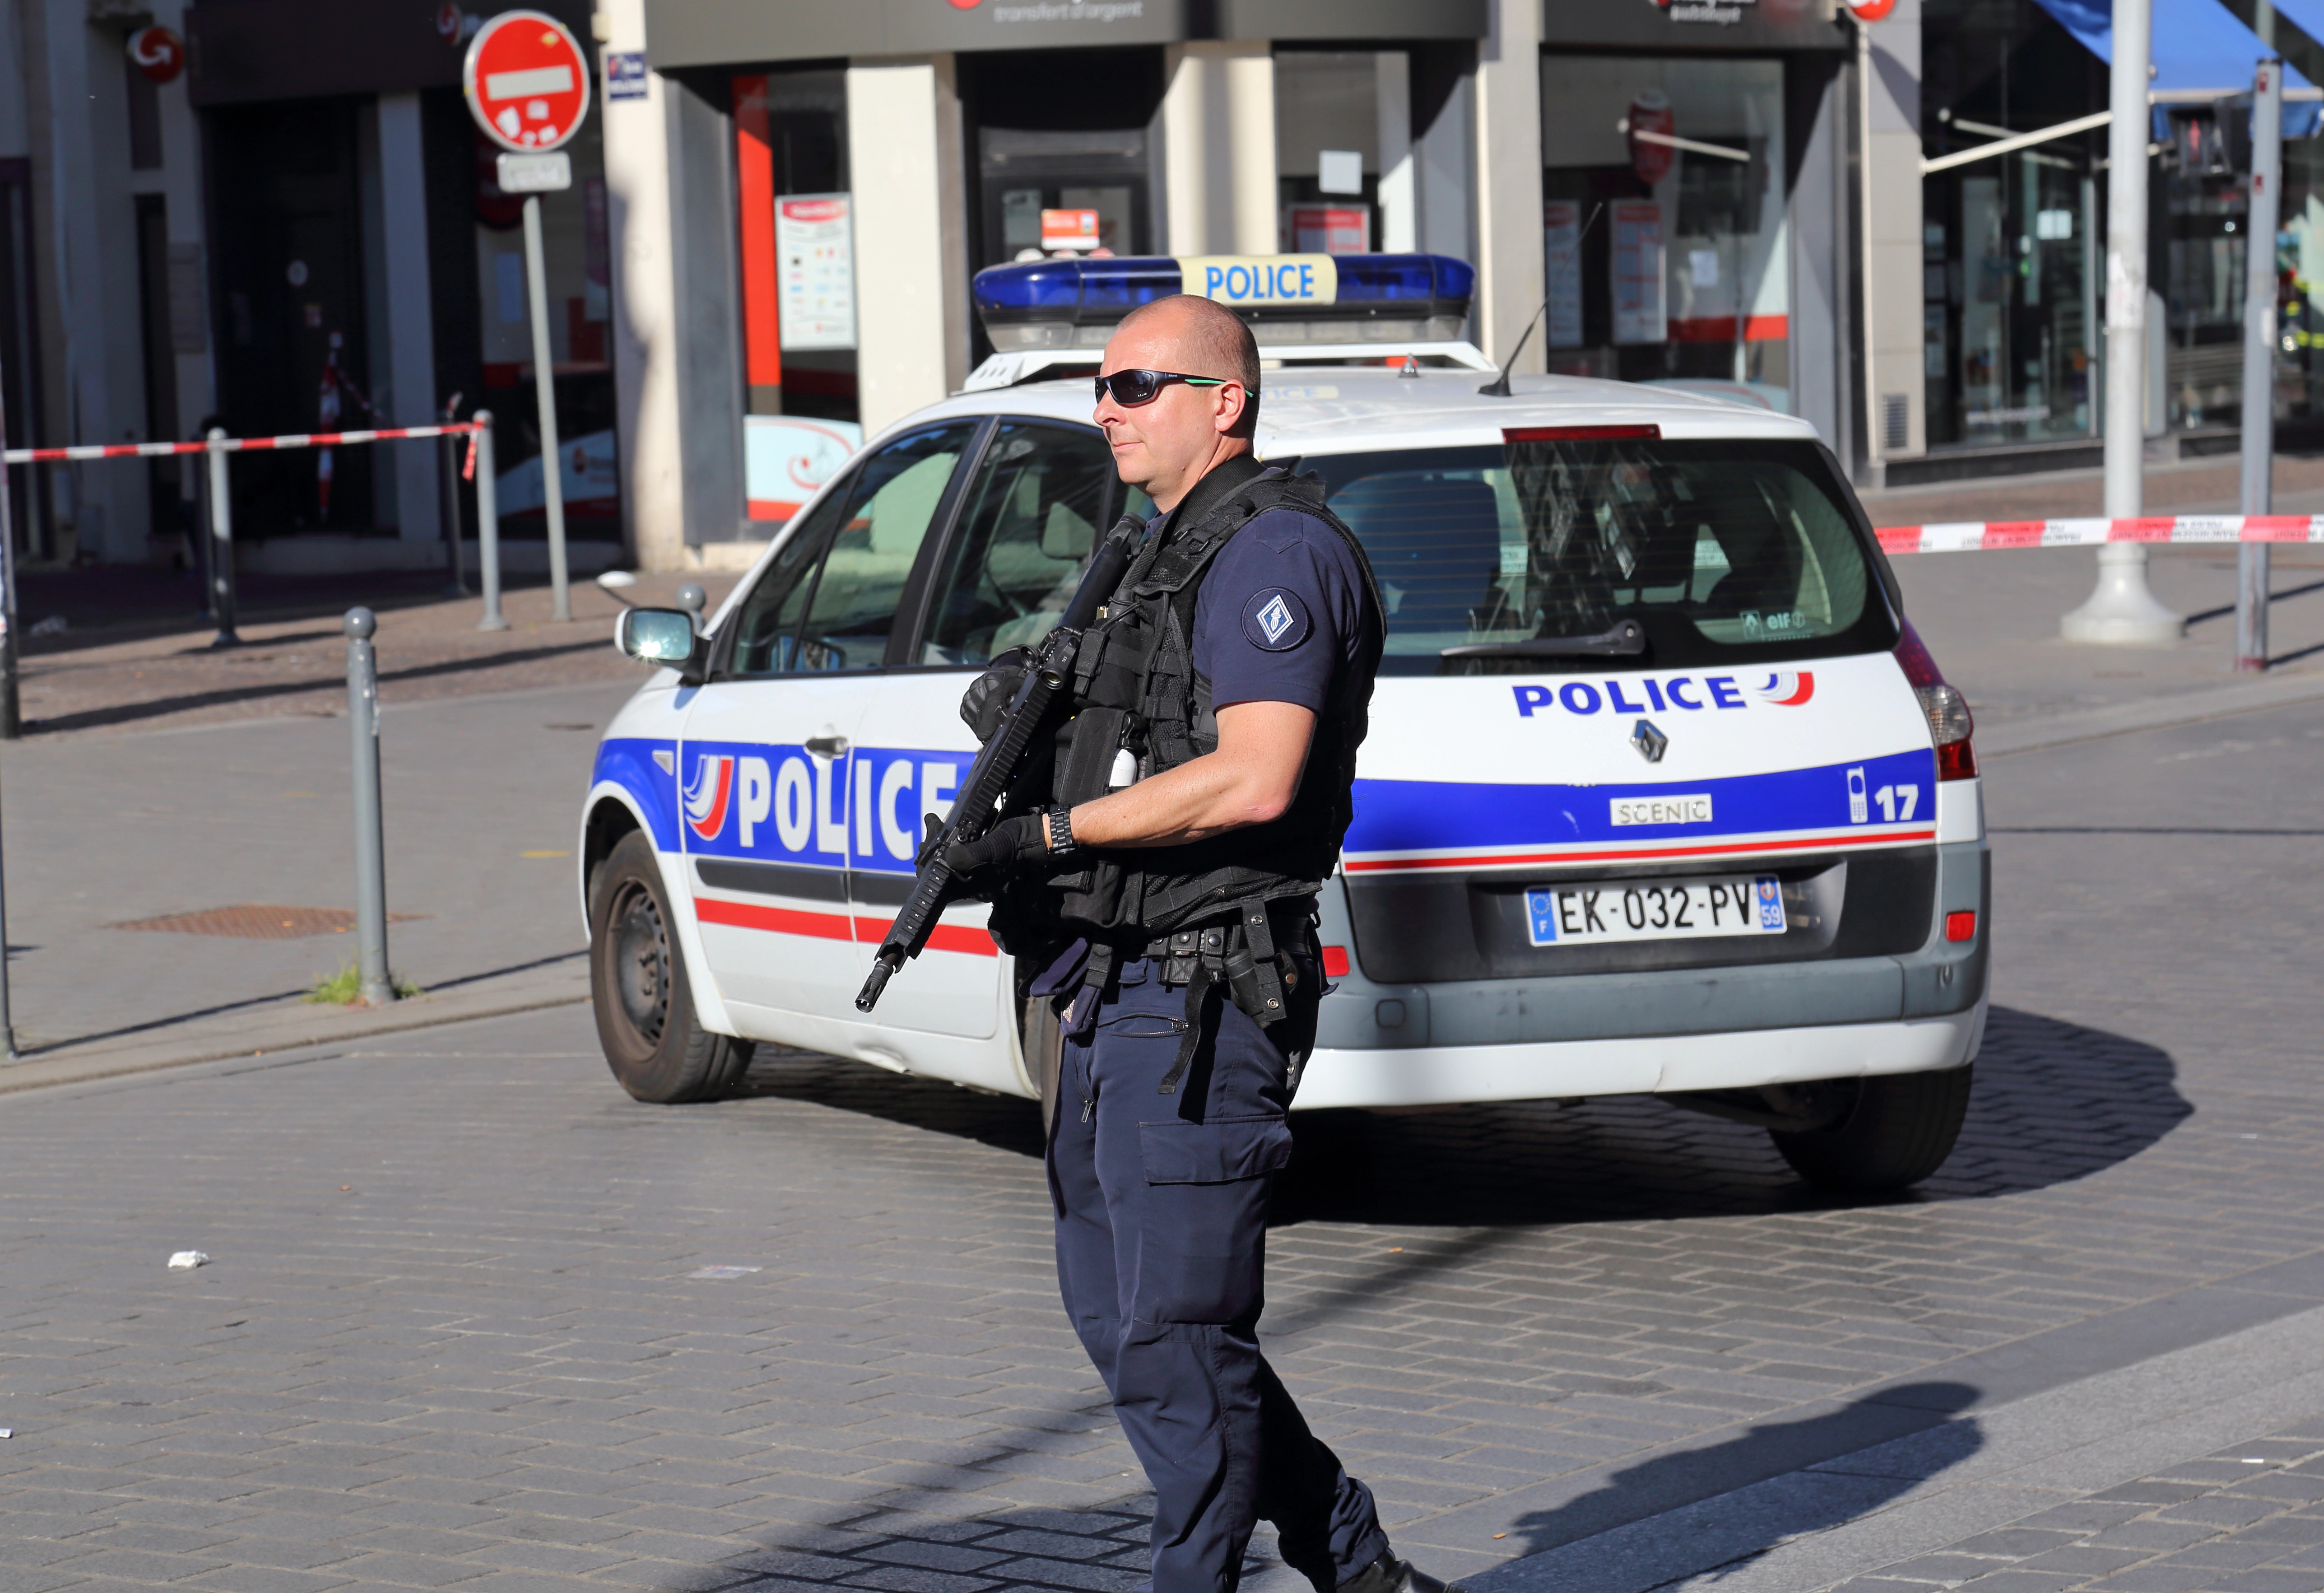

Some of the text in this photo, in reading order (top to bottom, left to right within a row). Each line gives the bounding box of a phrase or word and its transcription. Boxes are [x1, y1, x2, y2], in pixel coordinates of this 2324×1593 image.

[994, 2, 1069, 23] transfert
[1206, 265, 1314, 300] POLICE
[1766, 612, 1790, 630] elf
[1512, 677, 1748, 717] POLICE
[739, 756, 957, 861] POLICE
[1620, 800, 1707, 824] SCENIC
[1875, 784, 1918, 822] 17
[1558, 883, 1749, 934] EK-032-PV
[1762, 905, 1781, 926] 59
[1539, 920, 1548, 933] F
